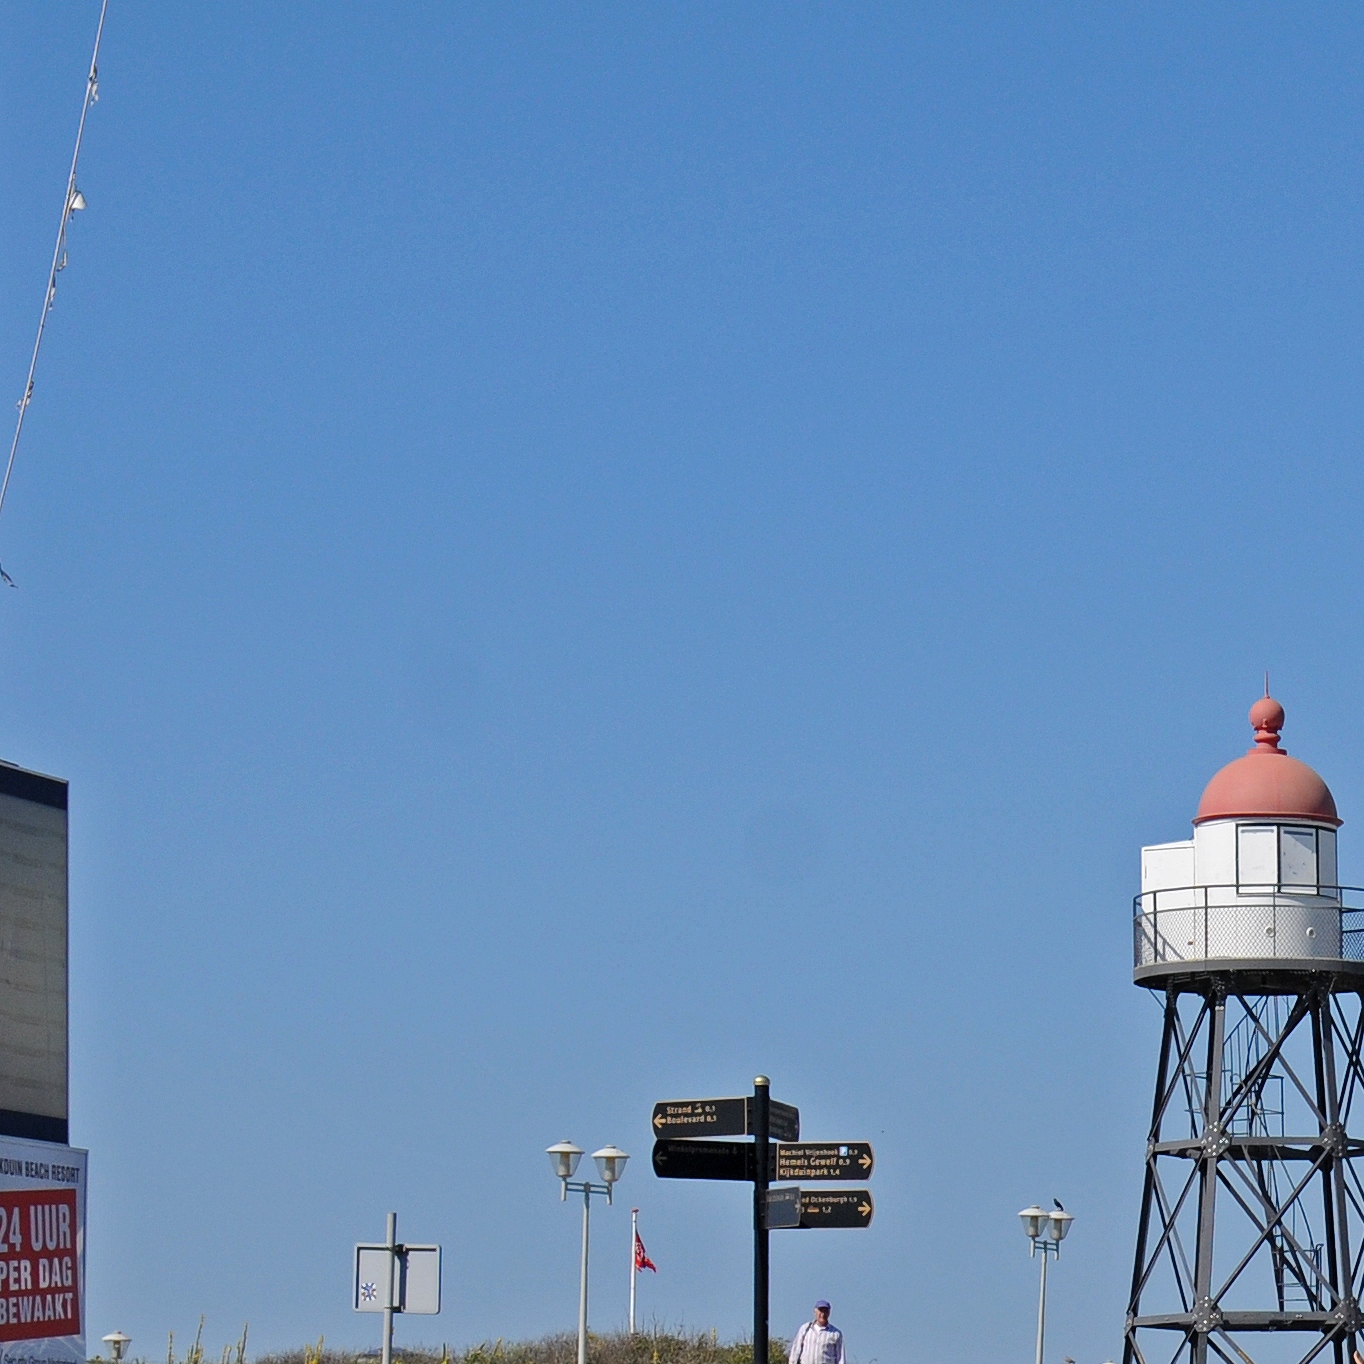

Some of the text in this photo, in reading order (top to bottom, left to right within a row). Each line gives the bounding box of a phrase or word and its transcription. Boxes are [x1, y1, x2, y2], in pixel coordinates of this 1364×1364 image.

[666, 1105, 692, 1115] Strand
[666, 1115, 705, 1125] Boulevard
[780, 1158, 808, 1166] Hemels
[25, 1161, 49, 1180] BEACH
[51, 1164, 80, 1184] RESORT
[780, 1168, 828, 1178] Kijkduinpark
[0, 1204, 71, 1254] 24 UUR
[0, 1256, 72, 1291] PER DAG
[0, 1292, 73, 1325] BEWAAKT
